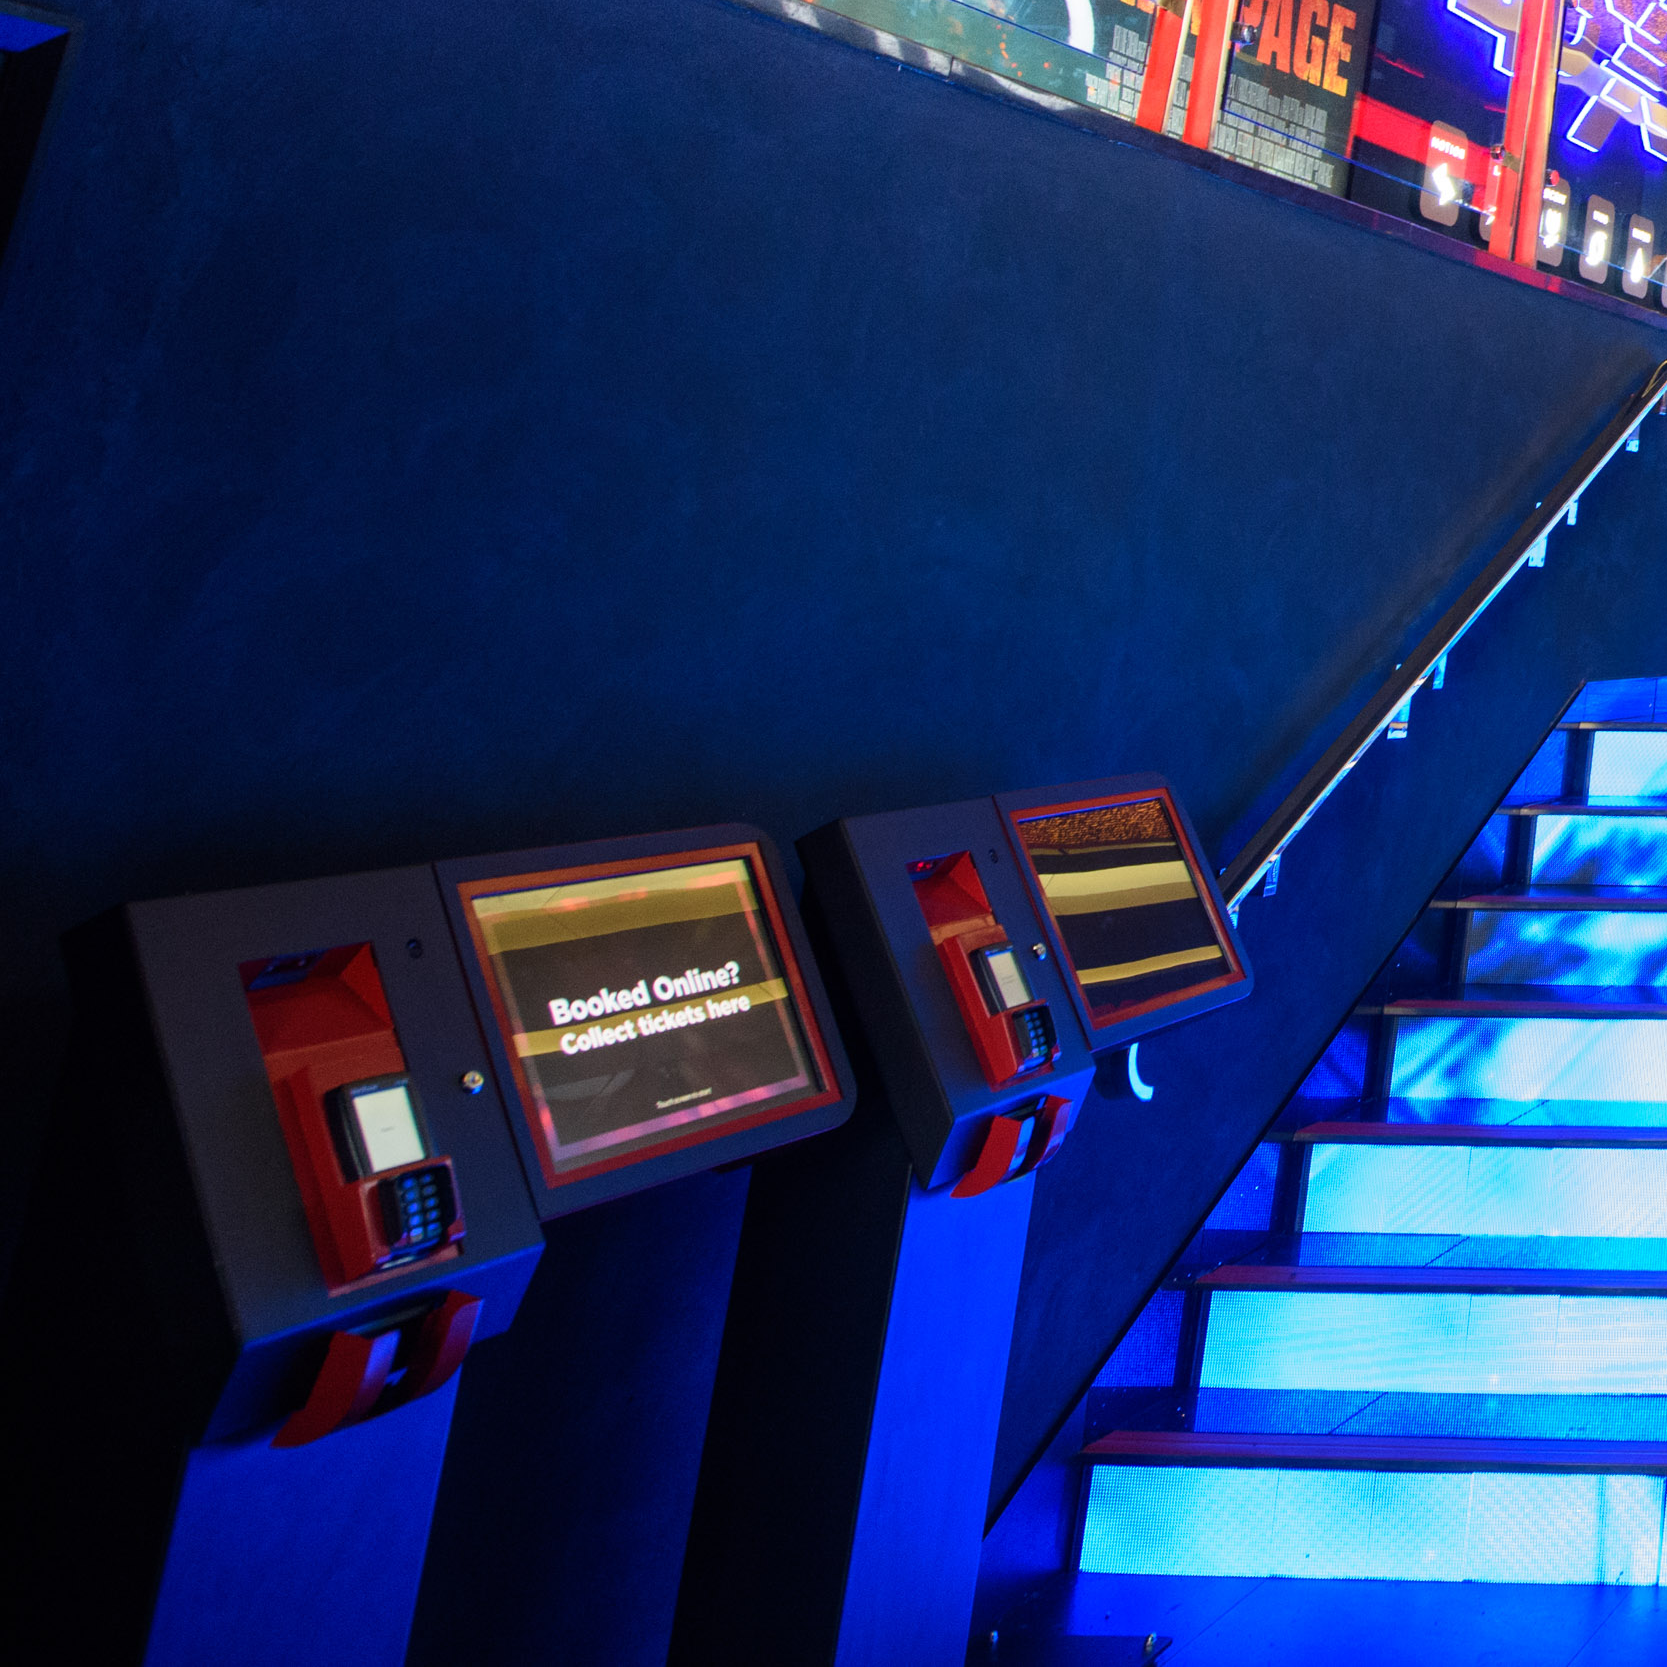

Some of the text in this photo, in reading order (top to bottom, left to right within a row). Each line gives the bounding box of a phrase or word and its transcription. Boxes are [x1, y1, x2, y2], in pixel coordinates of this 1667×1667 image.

[548, 961, 740, 1026] Booked Online?
[560, 995, 751, 1055] Collect tickets here
